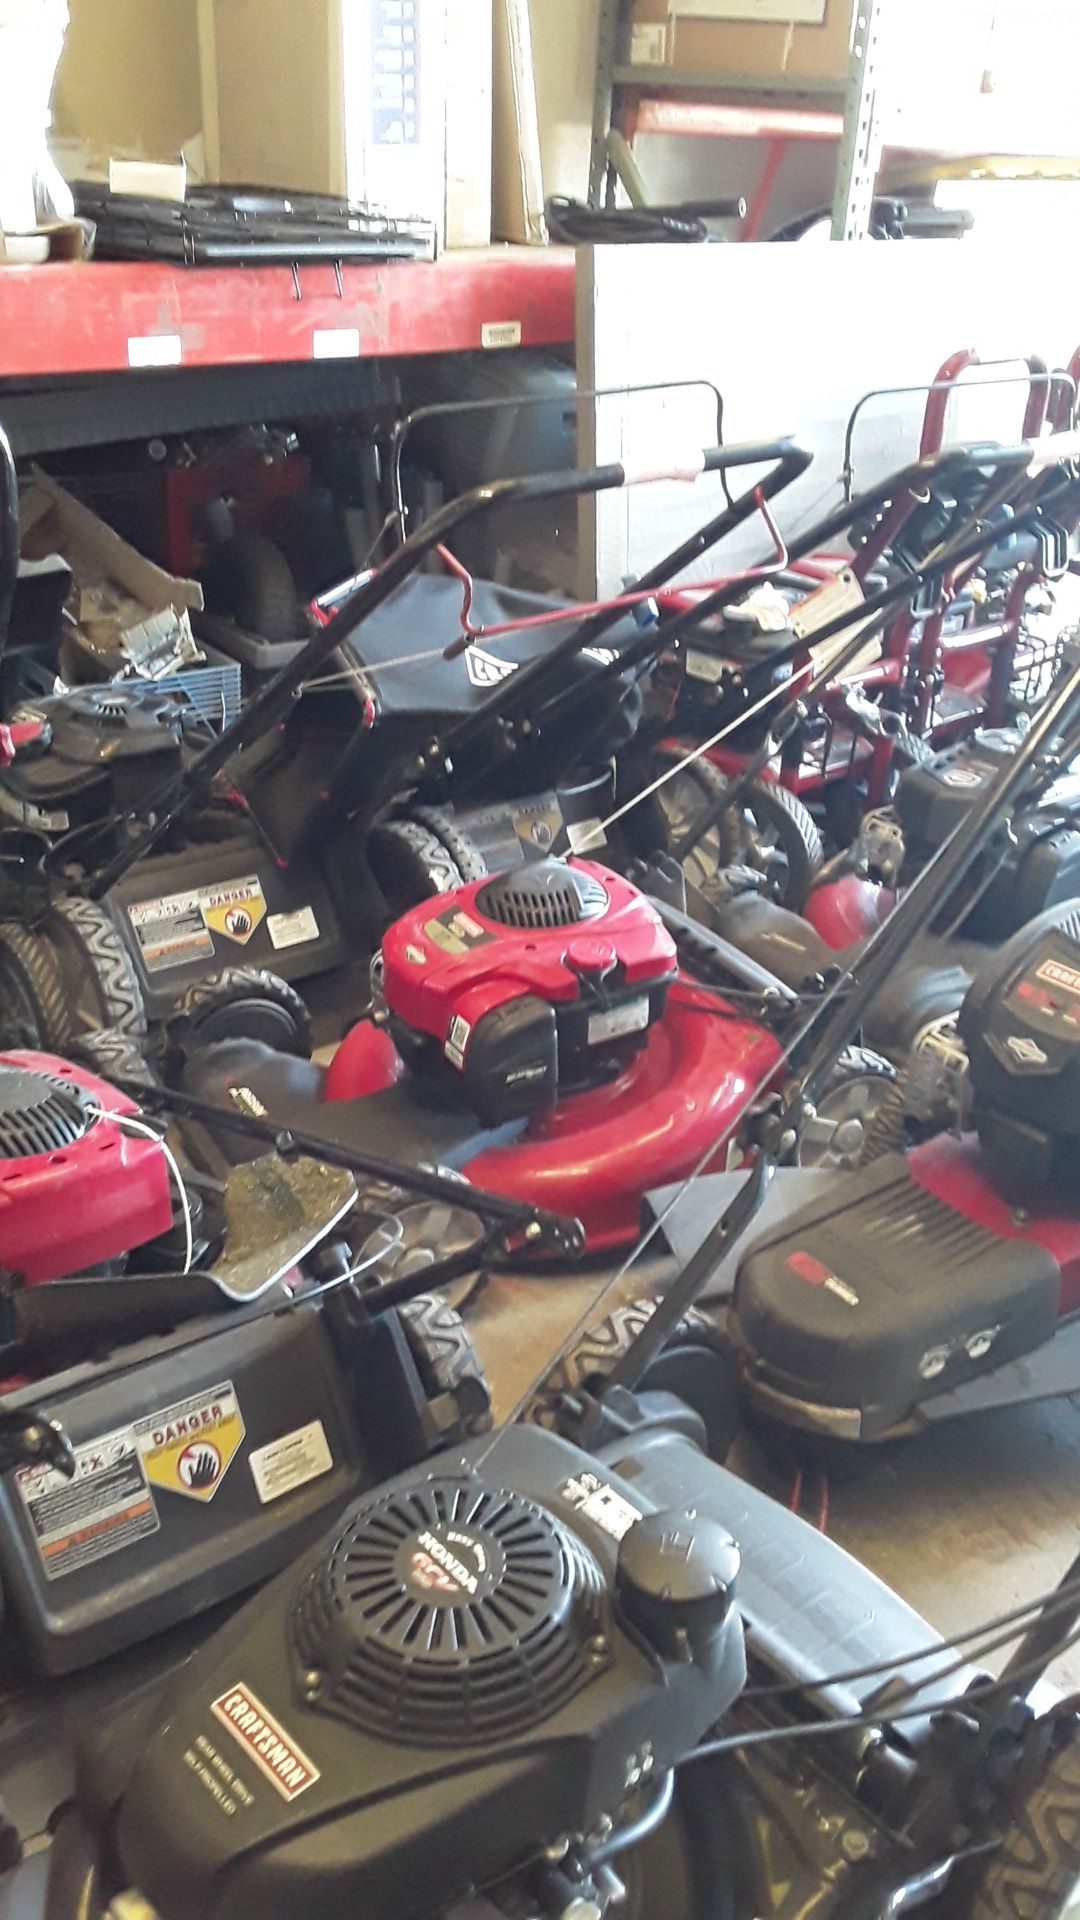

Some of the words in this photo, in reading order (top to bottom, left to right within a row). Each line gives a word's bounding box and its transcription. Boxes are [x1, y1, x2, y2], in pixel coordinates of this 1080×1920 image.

[152, 1404, 223, 1446] DANGER
[418, 1531, 478, 1594] HONDA
[224, 1693, 307, 1788] CRAFTSMAN
